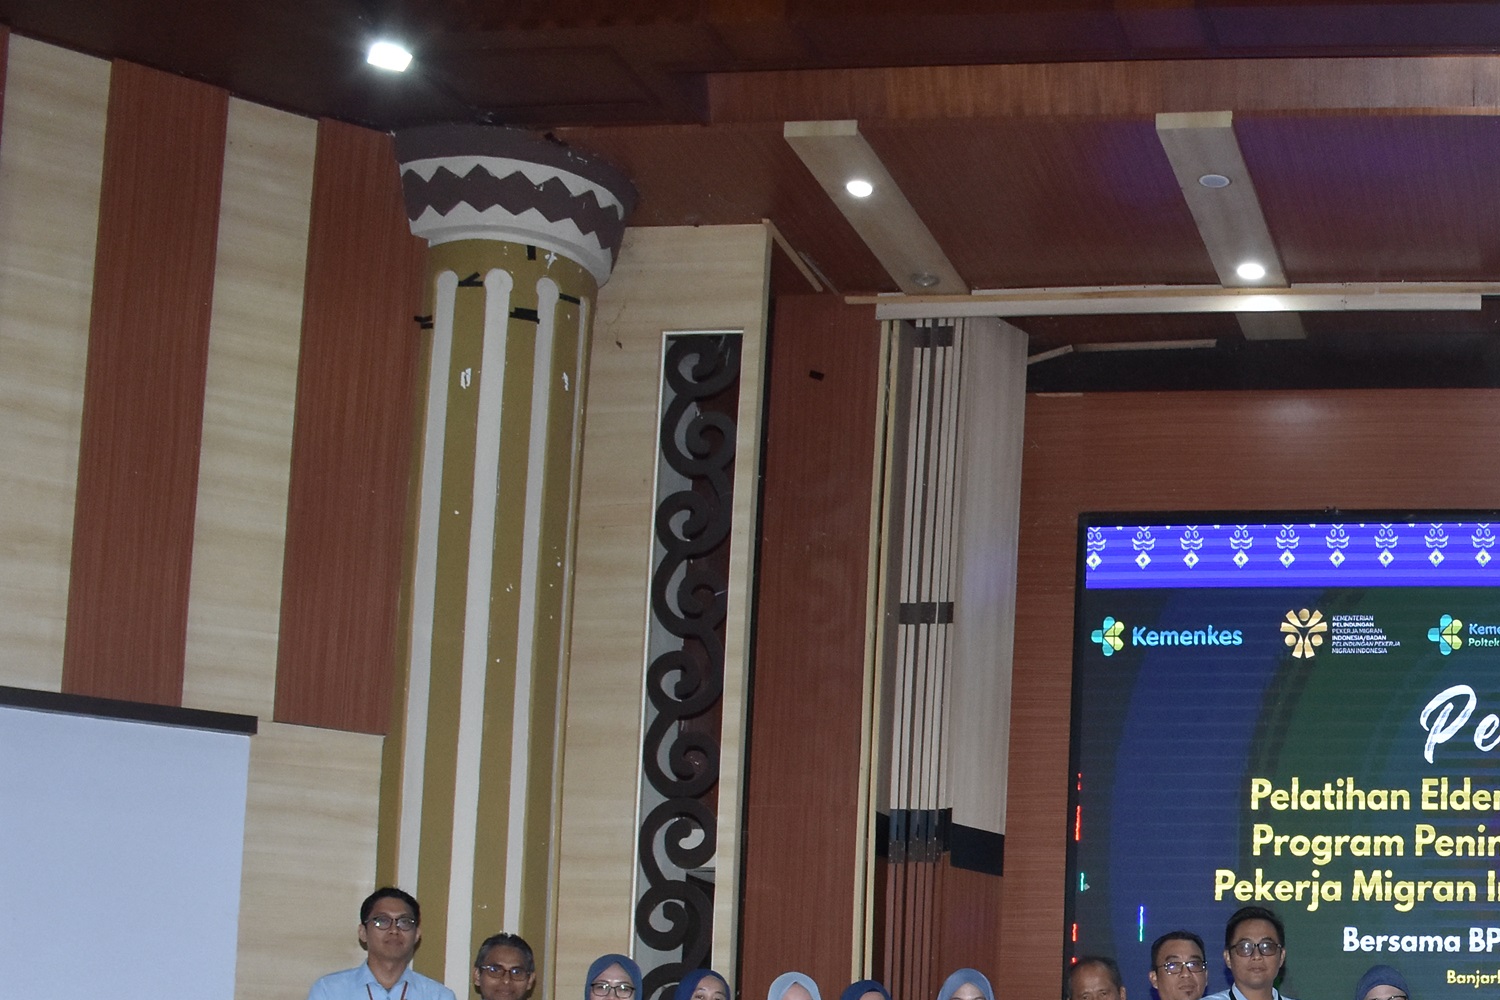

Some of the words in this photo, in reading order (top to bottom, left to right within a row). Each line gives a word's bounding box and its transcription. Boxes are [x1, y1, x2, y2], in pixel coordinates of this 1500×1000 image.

[1132, 625, 1243, 646] Kemenkes
[1250, 777, 1410, 811] Pelatihan
[1252, 824, 1404, 865] Program
[1214, 869, 1342, 911] Pekerja
[1352, 870, 1476, 912] Migran
[1343, 926, 1460, 952] Bersama
